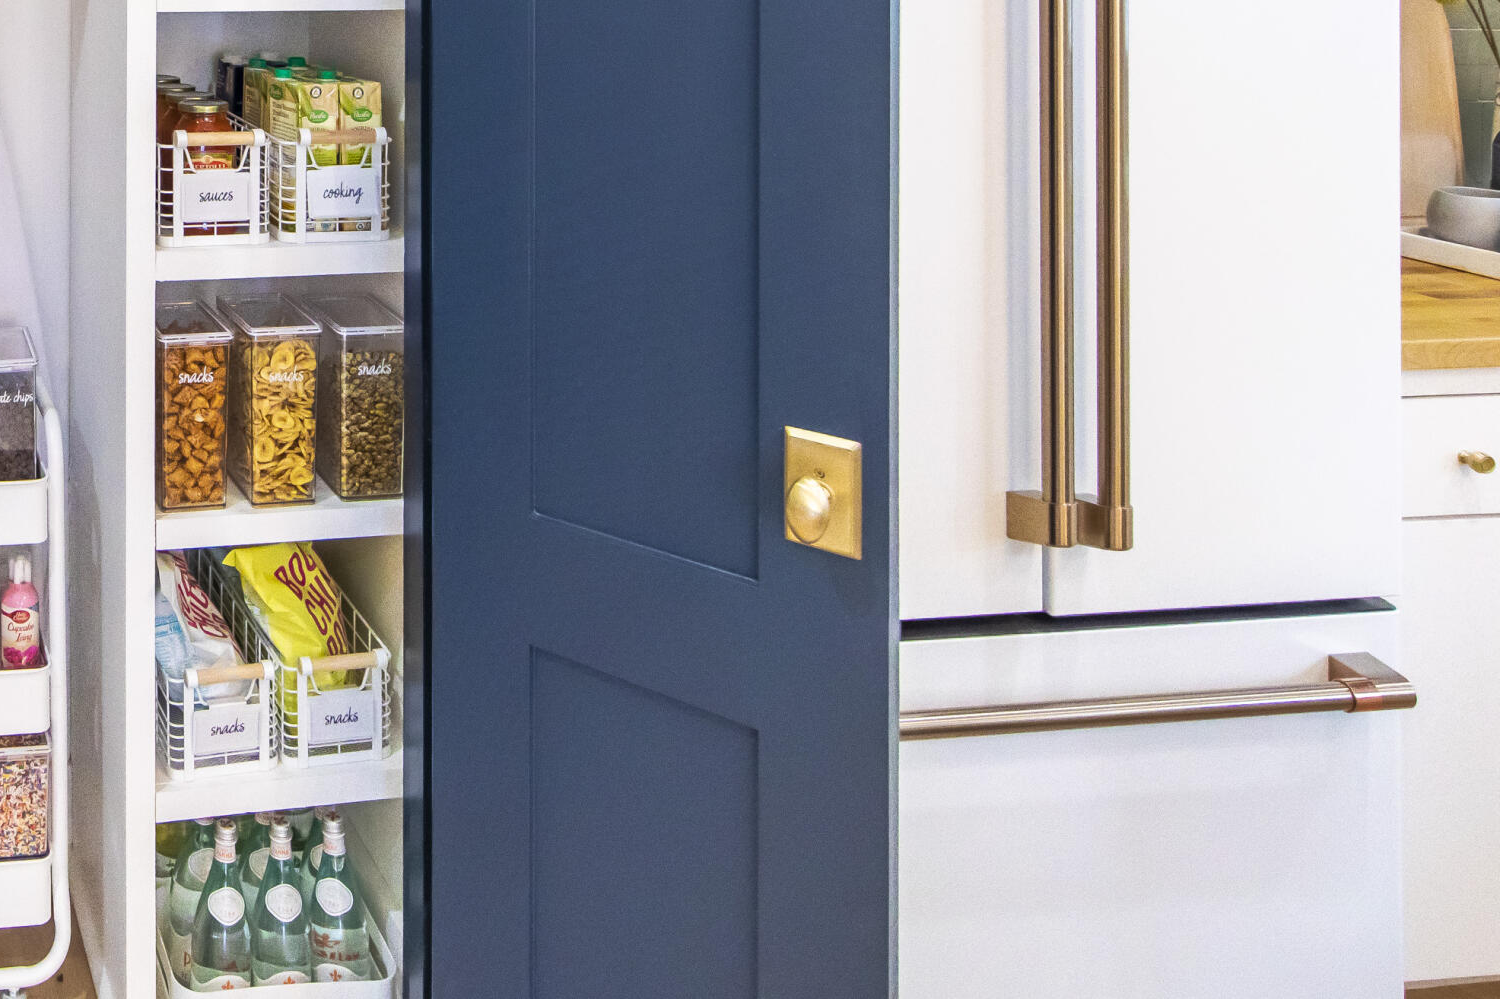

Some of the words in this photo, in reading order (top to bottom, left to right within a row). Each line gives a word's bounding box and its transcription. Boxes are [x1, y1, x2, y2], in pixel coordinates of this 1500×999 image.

[199, 190, 234, 203] sauces
[323, 184, 364, 205] cooking
[178, 365, 215, 385] snacks
[269, 364, 304, 384] snacks
[357, 358, 392, 376] snacks
[13, 389, 34, 407] chips
[324, 707, 359, 726] snacks
[210, 717, 245, 737] snacks
